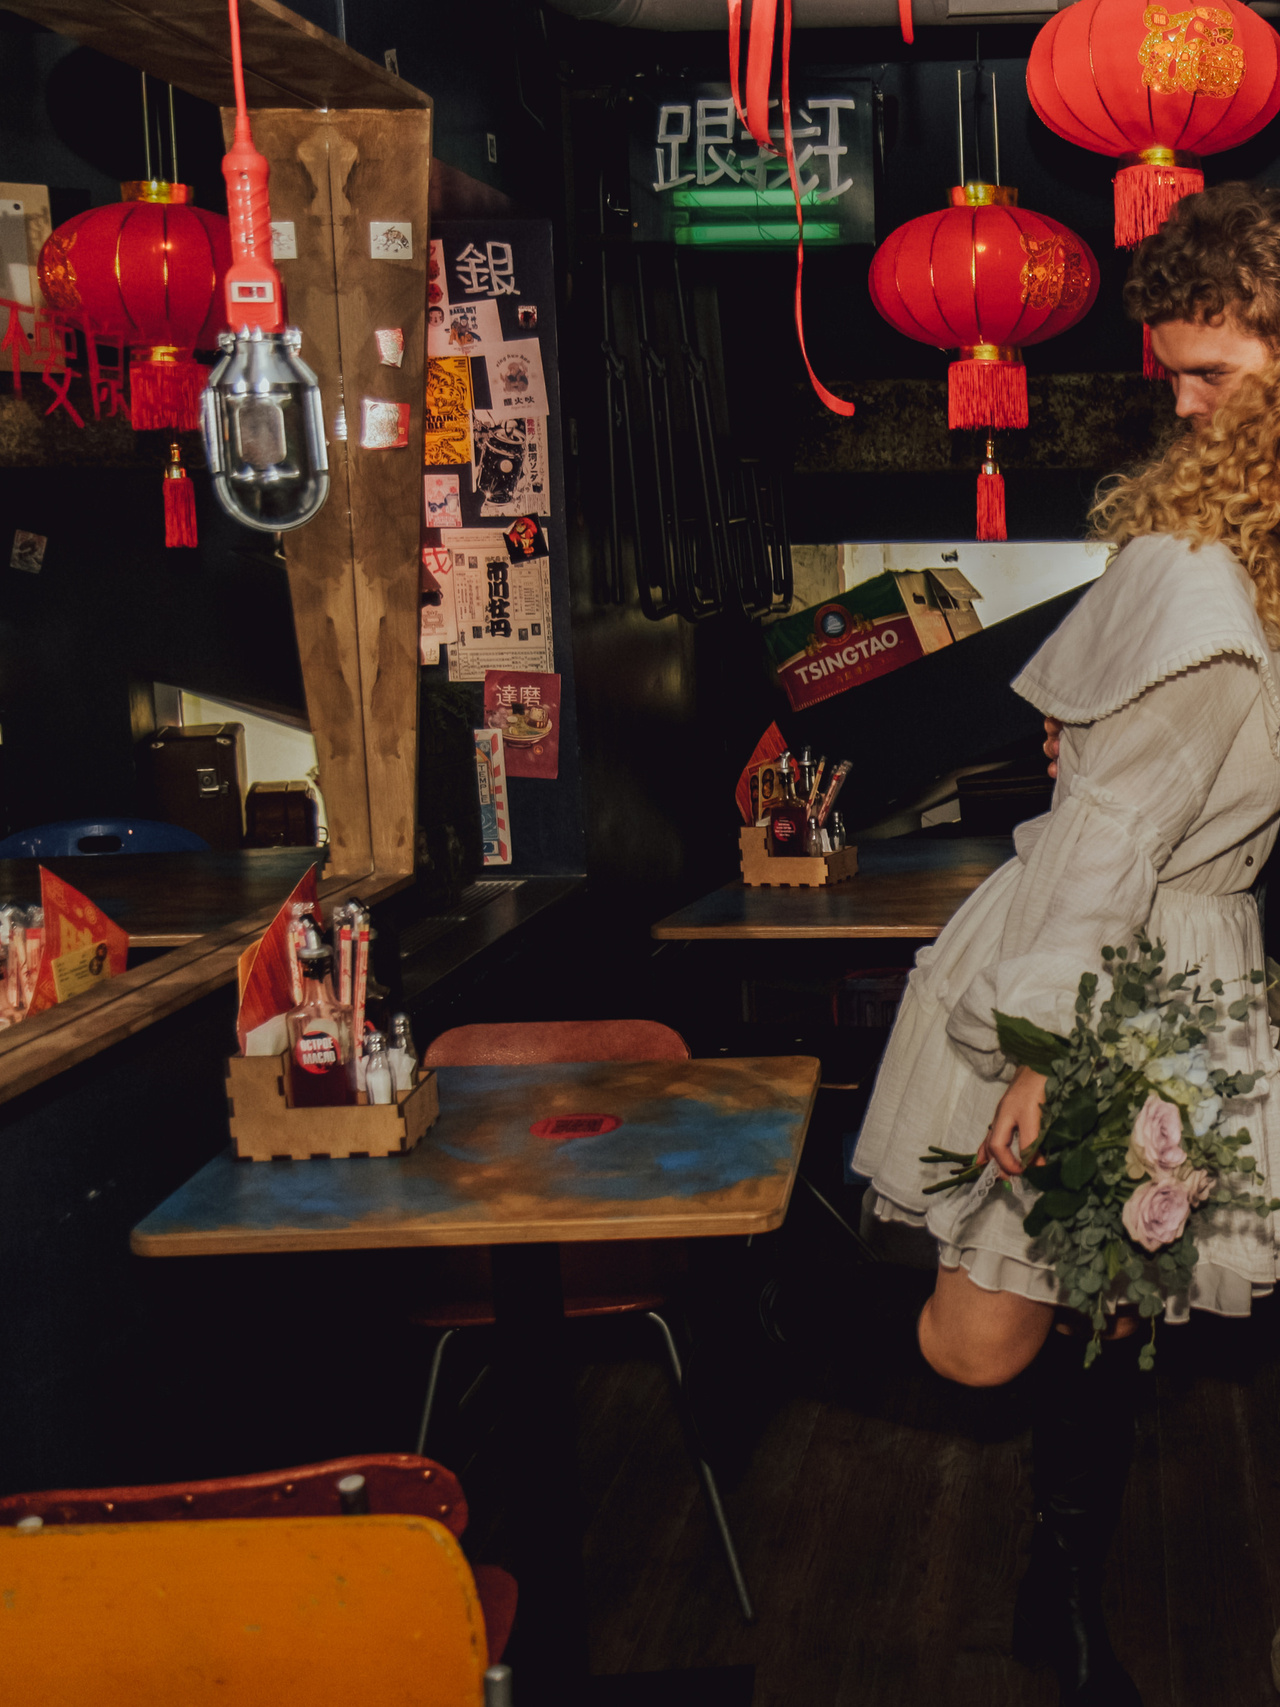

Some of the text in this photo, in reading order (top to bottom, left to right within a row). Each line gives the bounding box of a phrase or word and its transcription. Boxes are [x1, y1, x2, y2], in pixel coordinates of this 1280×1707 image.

[456, 241, 521, 296] 銀
[794, 630, 898, 685] TSINGTAO
[496, 685, 541, 707] 達磨
[478, 764, 489, 803] TEMPLE
